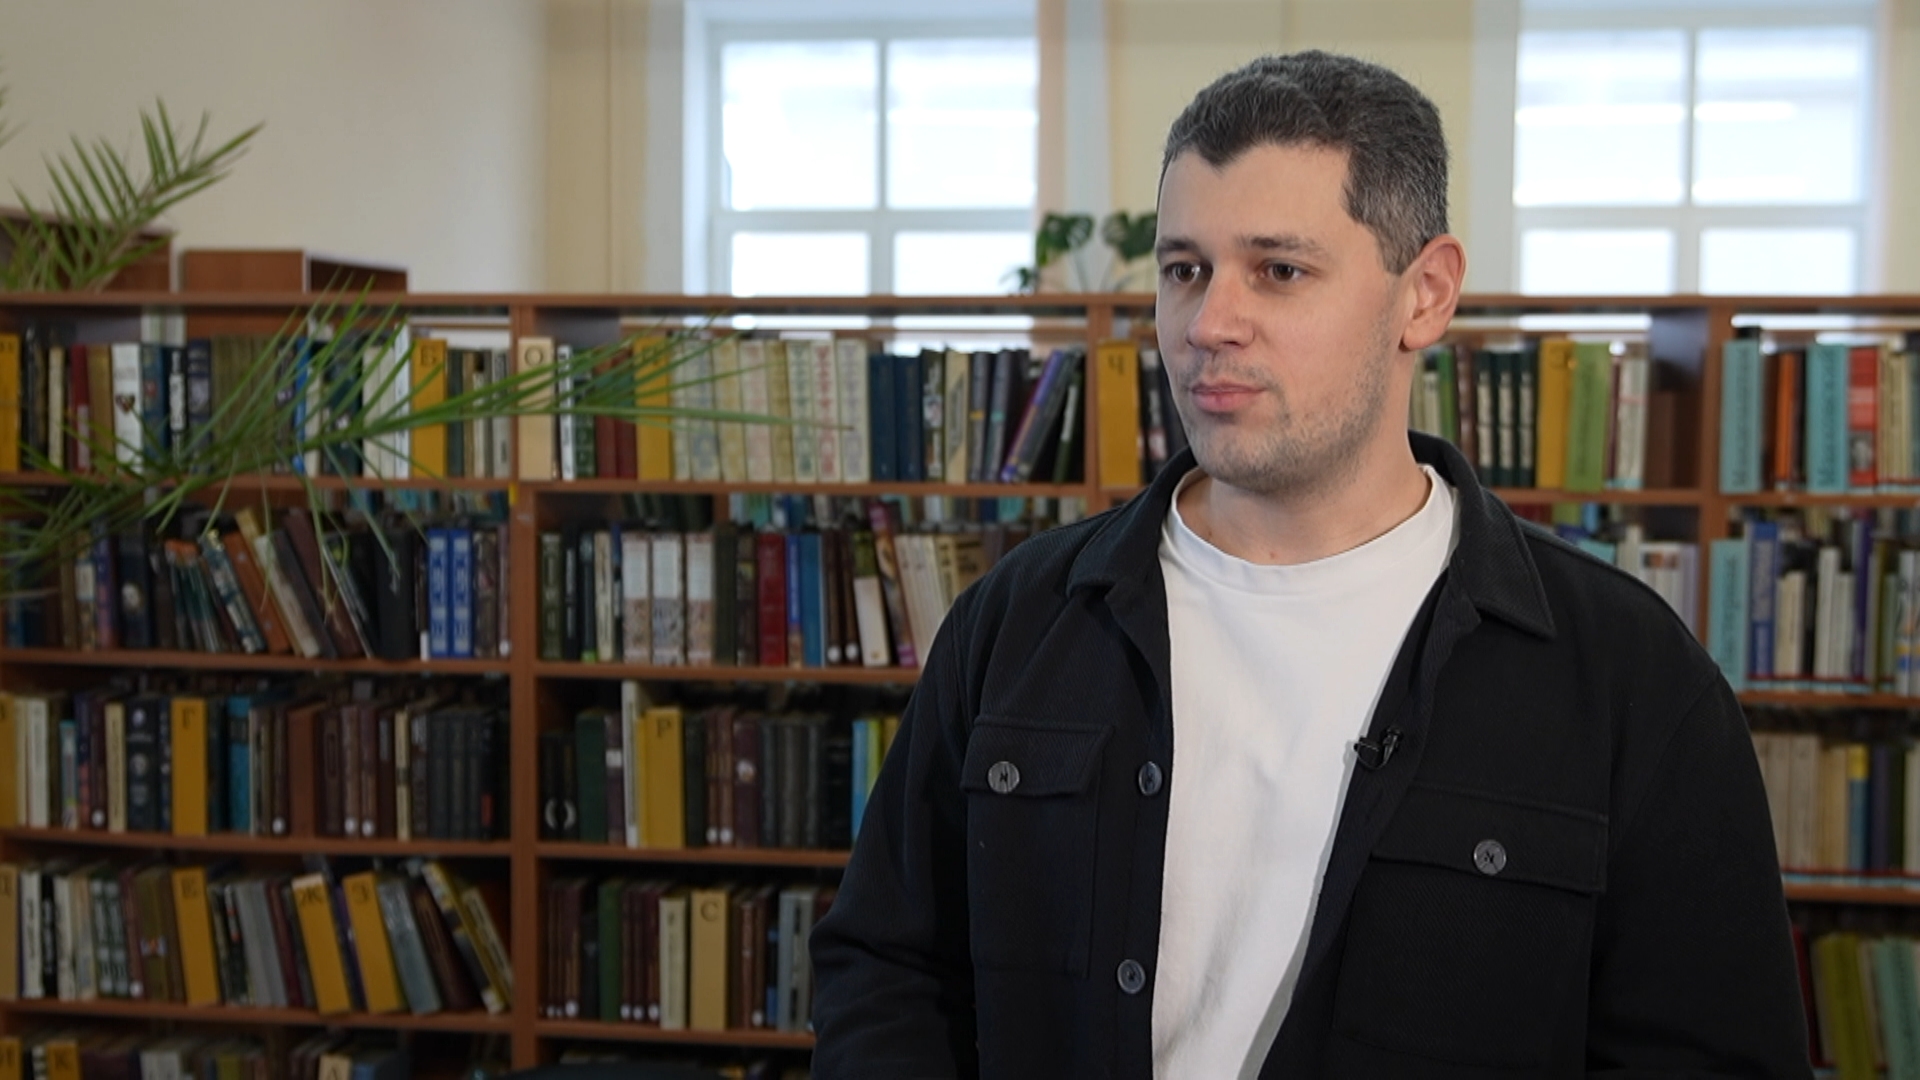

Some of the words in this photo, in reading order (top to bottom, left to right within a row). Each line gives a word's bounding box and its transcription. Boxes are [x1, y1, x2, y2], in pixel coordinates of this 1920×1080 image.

[656, 716, 672, 739] Р
[301, 887, 324, 906] Ж
[699, 899, 720, 922] С
[54, 1050, 71, 1071] К
